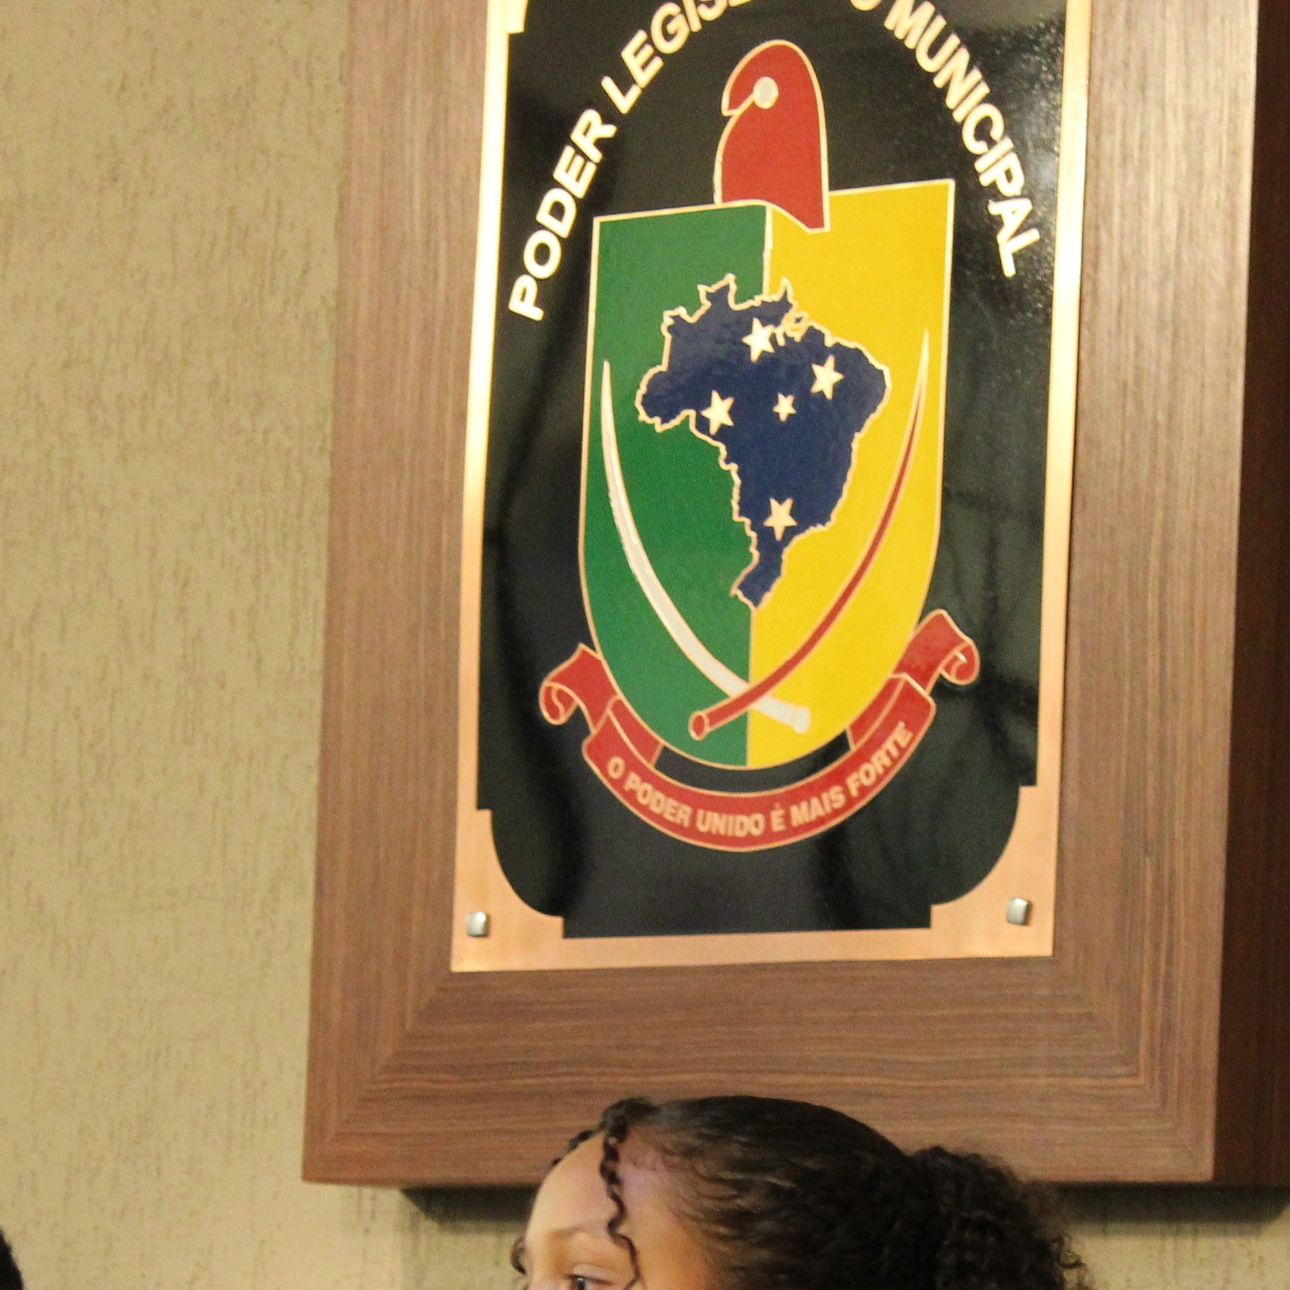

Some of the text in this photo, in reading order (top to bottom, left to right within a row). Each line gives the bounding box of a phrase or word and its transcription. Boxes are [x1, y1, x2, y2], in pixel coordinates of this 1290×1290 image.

[508, 107, 617, 321] PODER
[883, 0, 1040, 277] MUNICIPAL
[607, 721, 914, 838] O PODER UNIDO É MAIS FORTE
